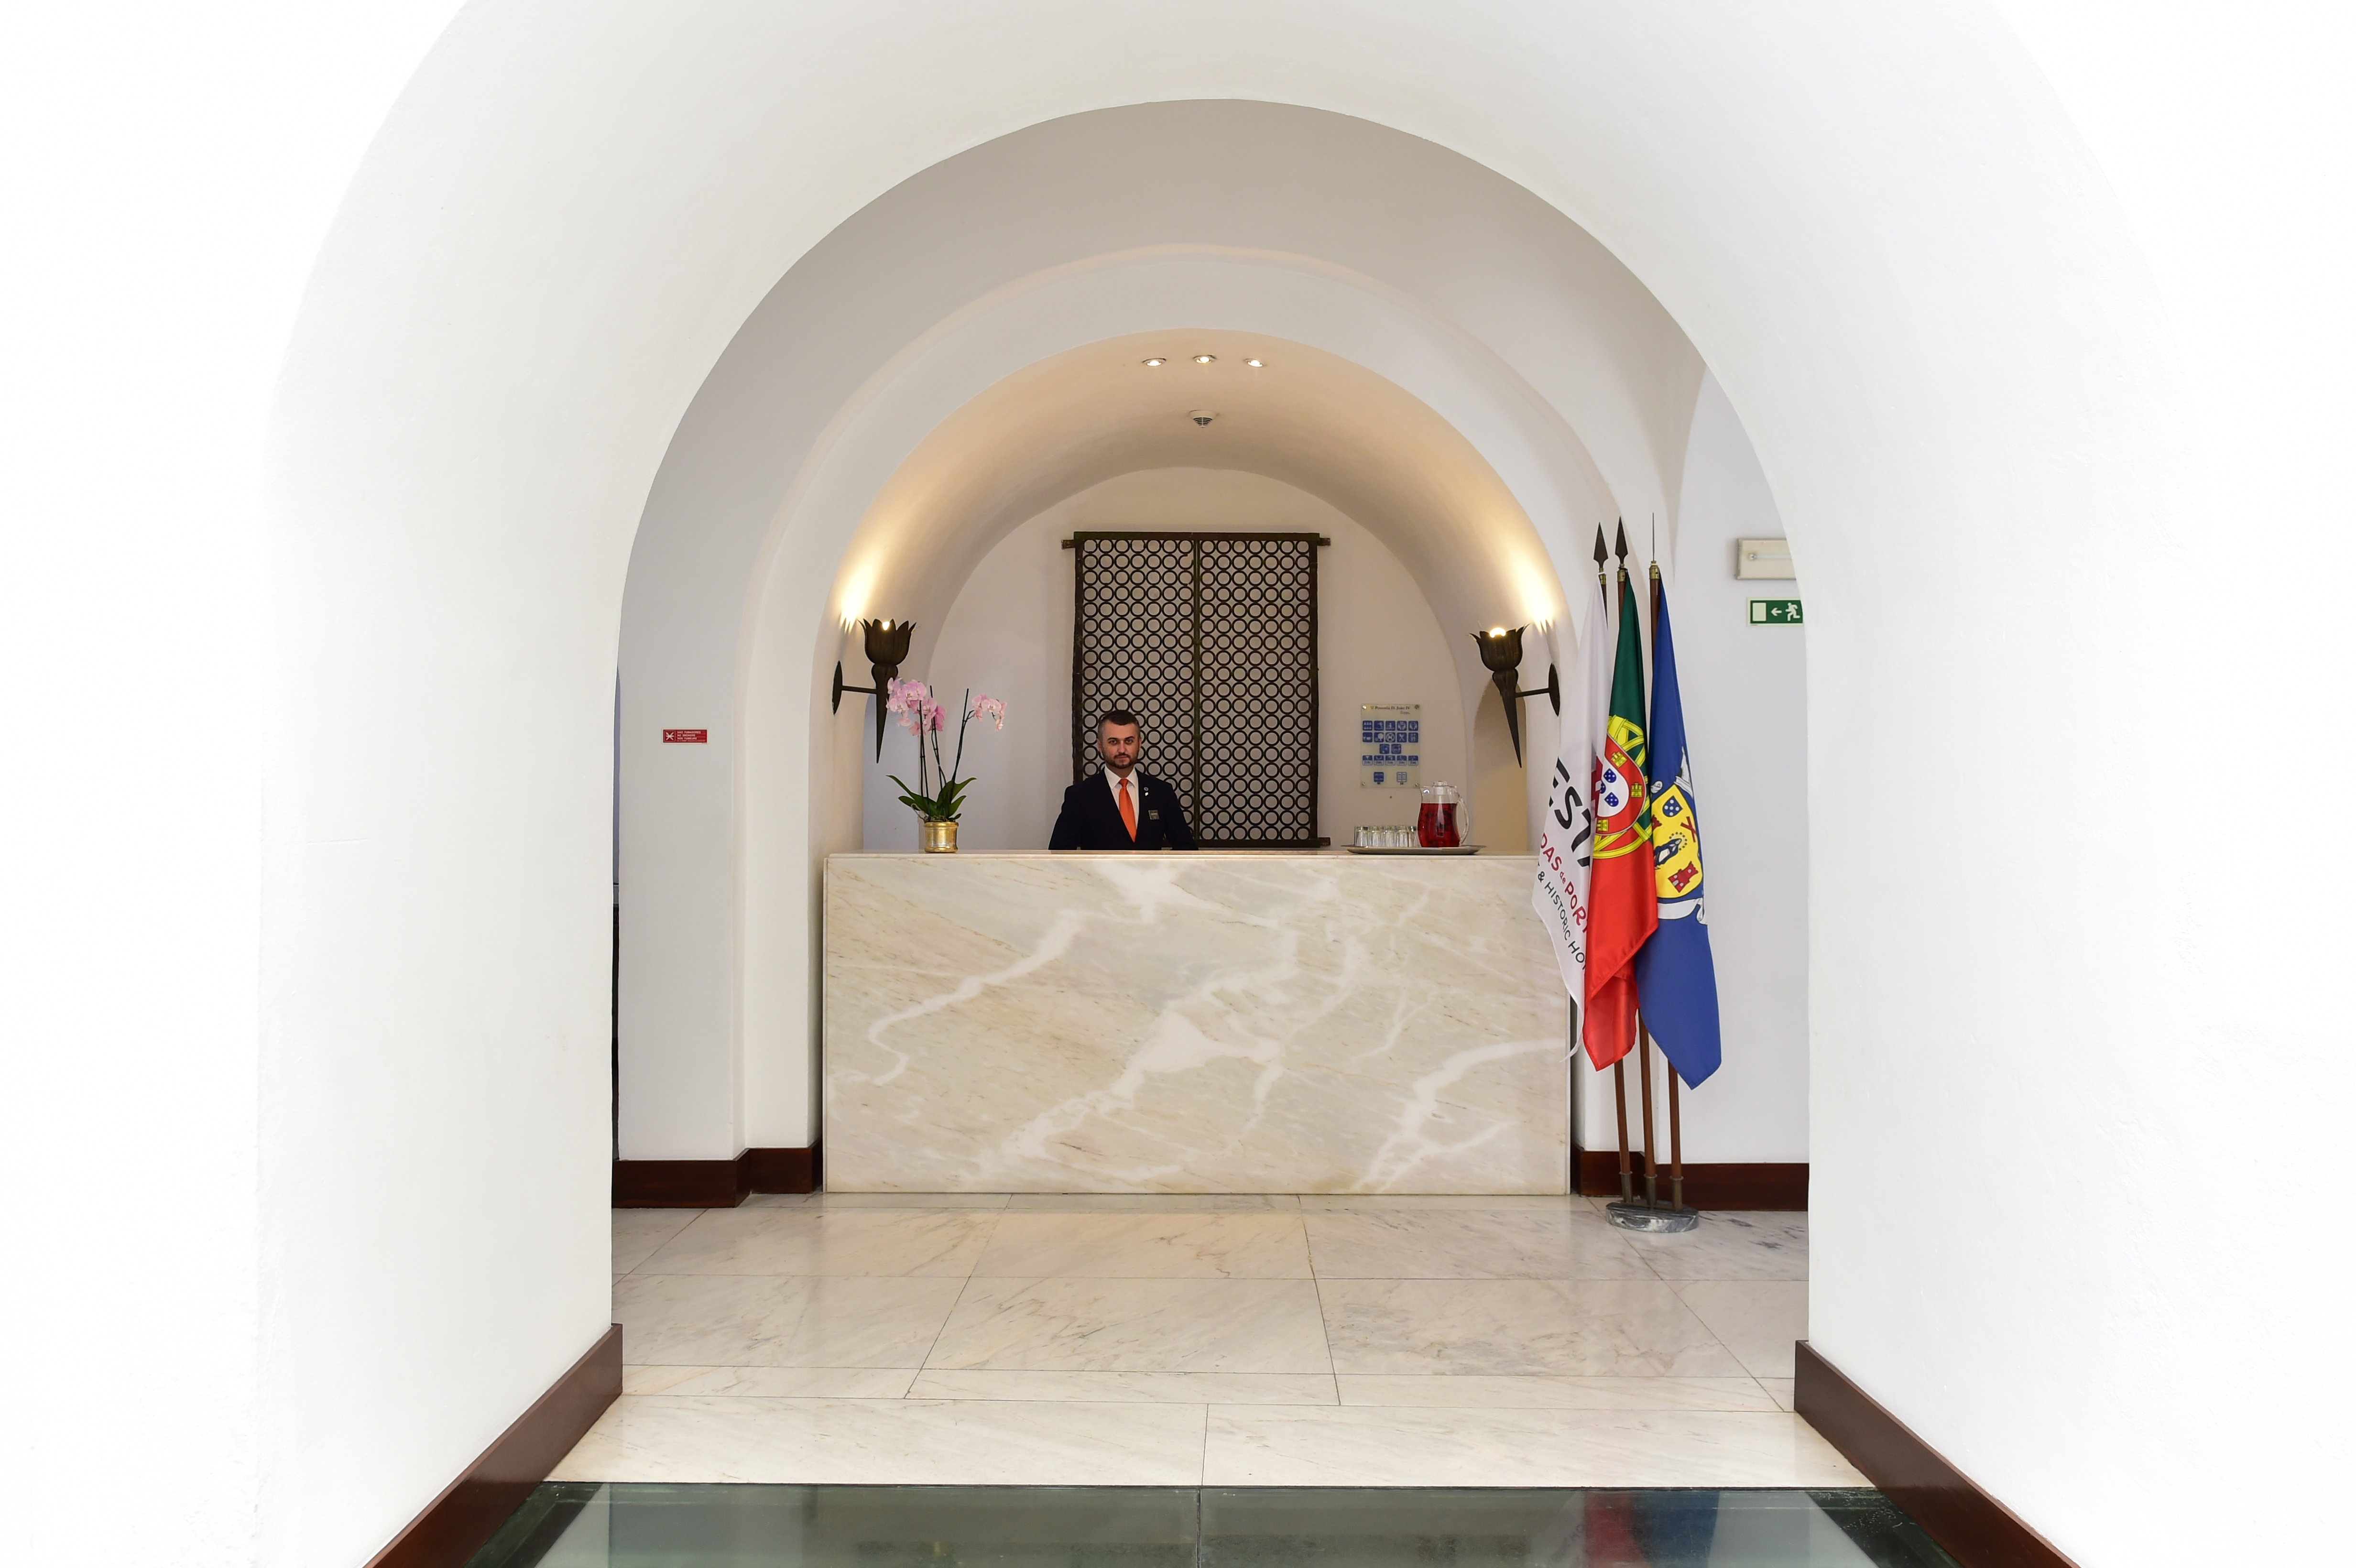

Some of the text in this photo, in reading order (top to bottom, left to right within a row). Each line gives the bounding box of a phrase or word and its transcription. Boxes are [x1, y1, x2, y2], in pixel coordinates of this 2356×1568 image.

[1538, 871, 1586, 970] & HISTORIC HO
[1560, 871, 1566, 884] de
[1565, 881, 1587, 933] POR
